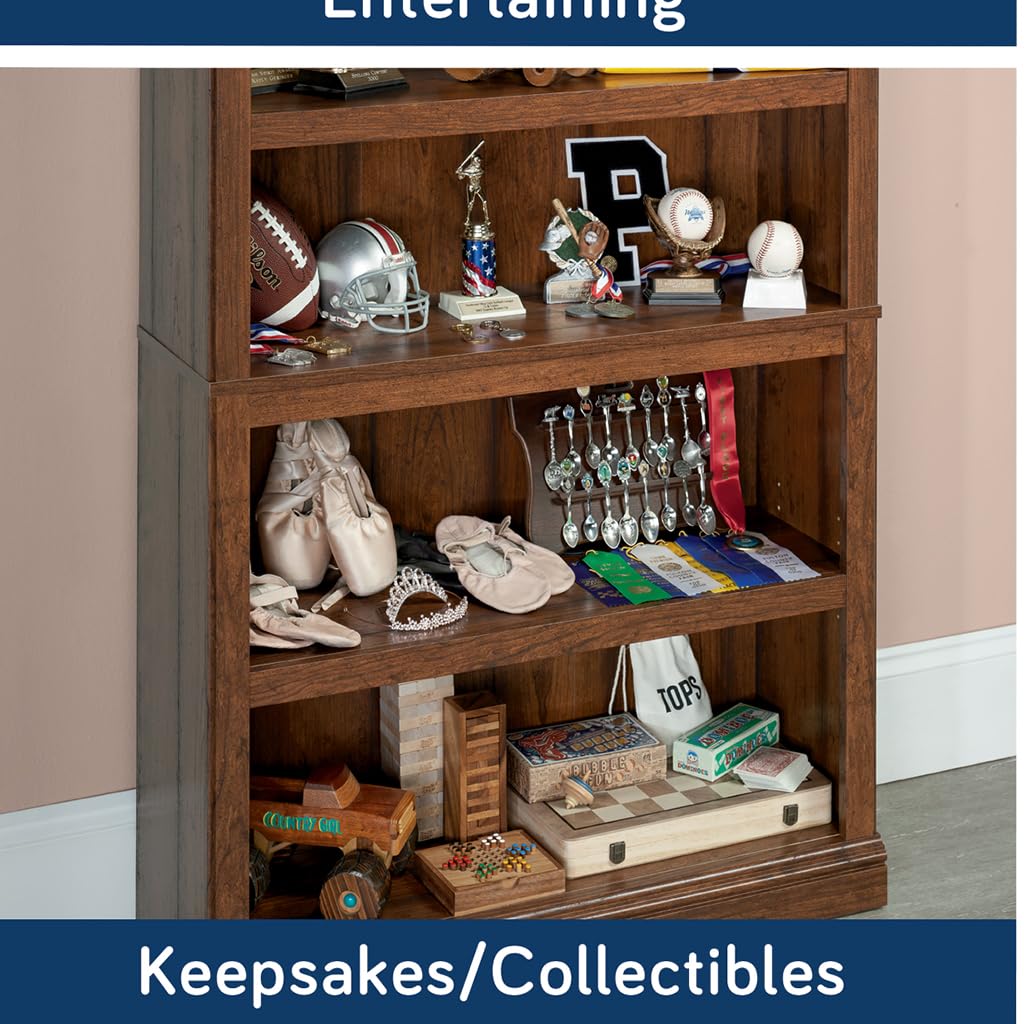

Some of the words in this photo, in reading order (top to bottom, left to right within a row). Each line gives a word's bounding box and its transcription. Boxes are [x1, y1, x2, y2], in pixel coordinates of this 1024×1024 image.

[657, 675, 702, 713] TOPS
[573, 757, 626, 776] BUBBLE
[677, 762, 709, 776] DOMINOES
[263, 811, 317, 833] COUNTRY
